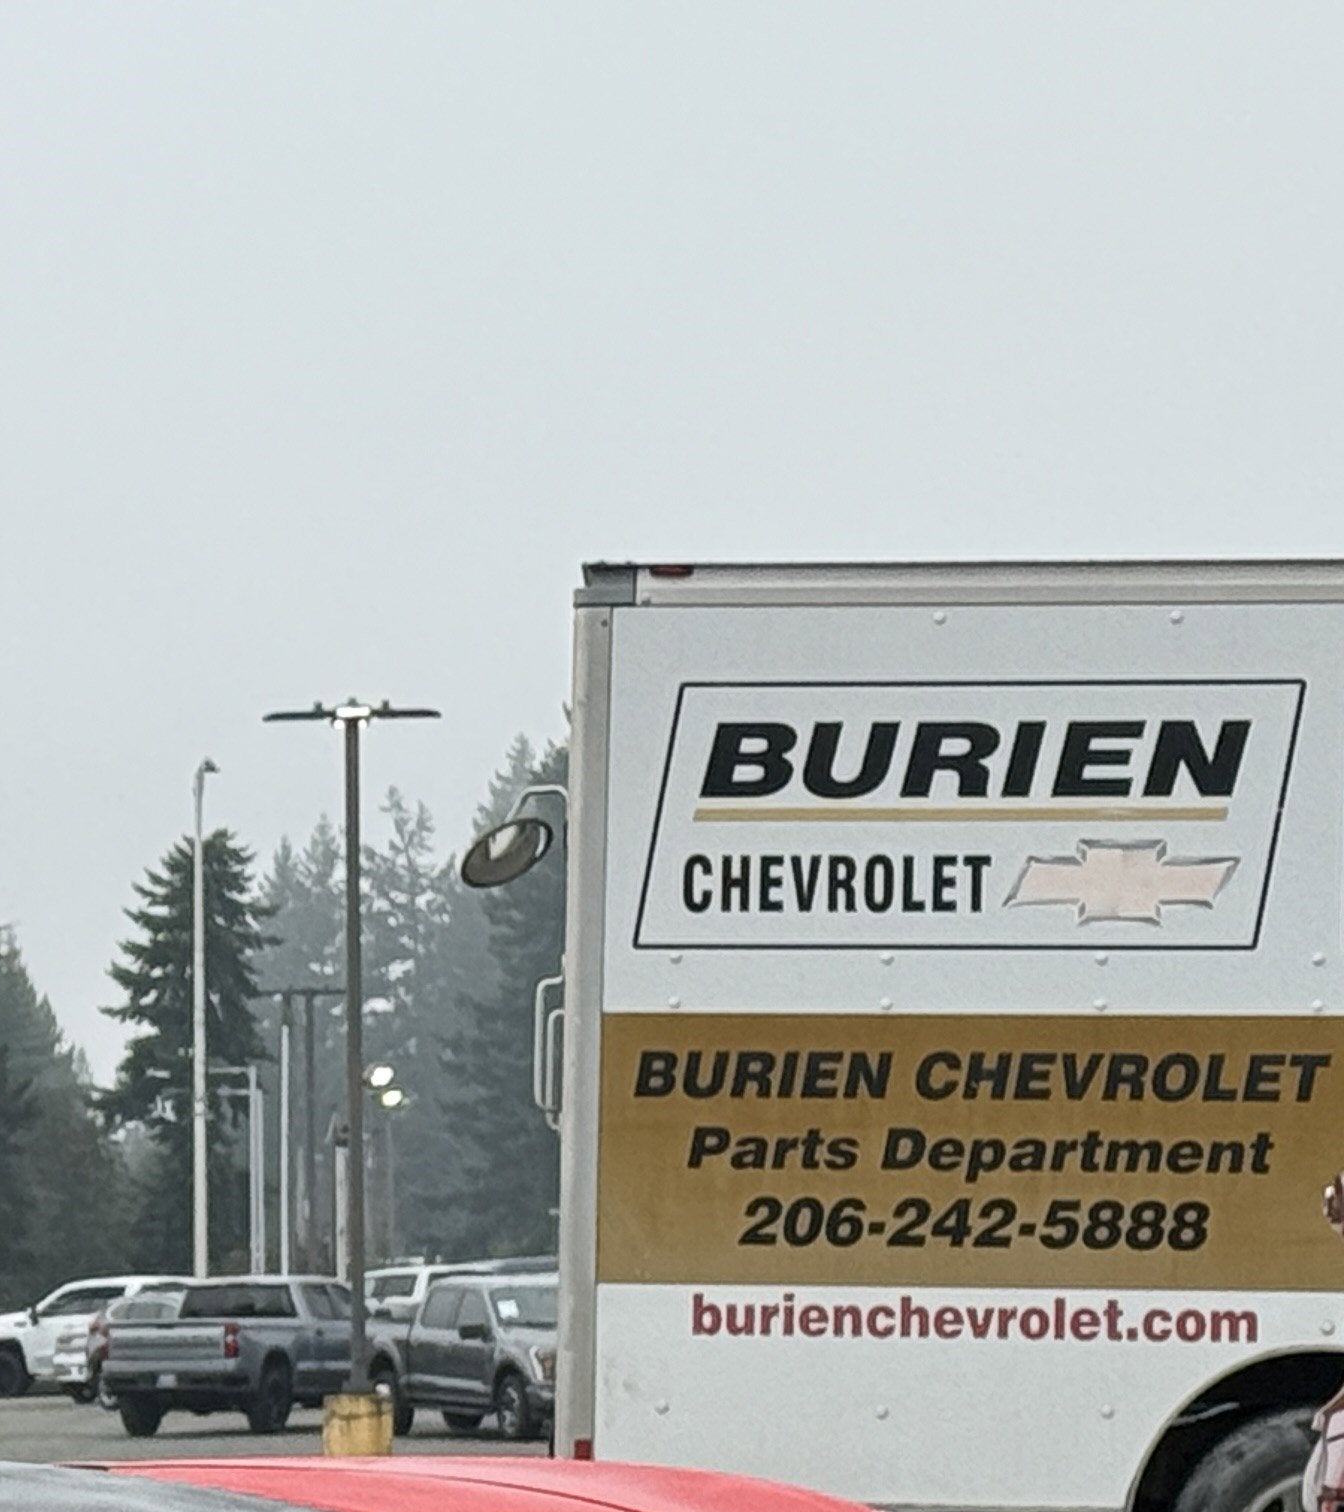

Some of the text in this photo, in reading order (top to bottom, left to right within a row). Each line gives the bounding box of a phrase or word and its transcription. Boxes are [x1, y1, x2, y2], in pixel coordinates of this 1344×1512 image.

[698, 719, 1252, 799] BURIEN
[681, 853, 993, 914] CHEVROLET
[632, 1049, 1333, 1104] BURIEN CHEVROLET
[686, 1125, 1276, 1185] Parts Department
[737, 1195, 1211, 1253] 206-242-5888
[691, 1293, 1260, 1344] burienchevrolet.com
